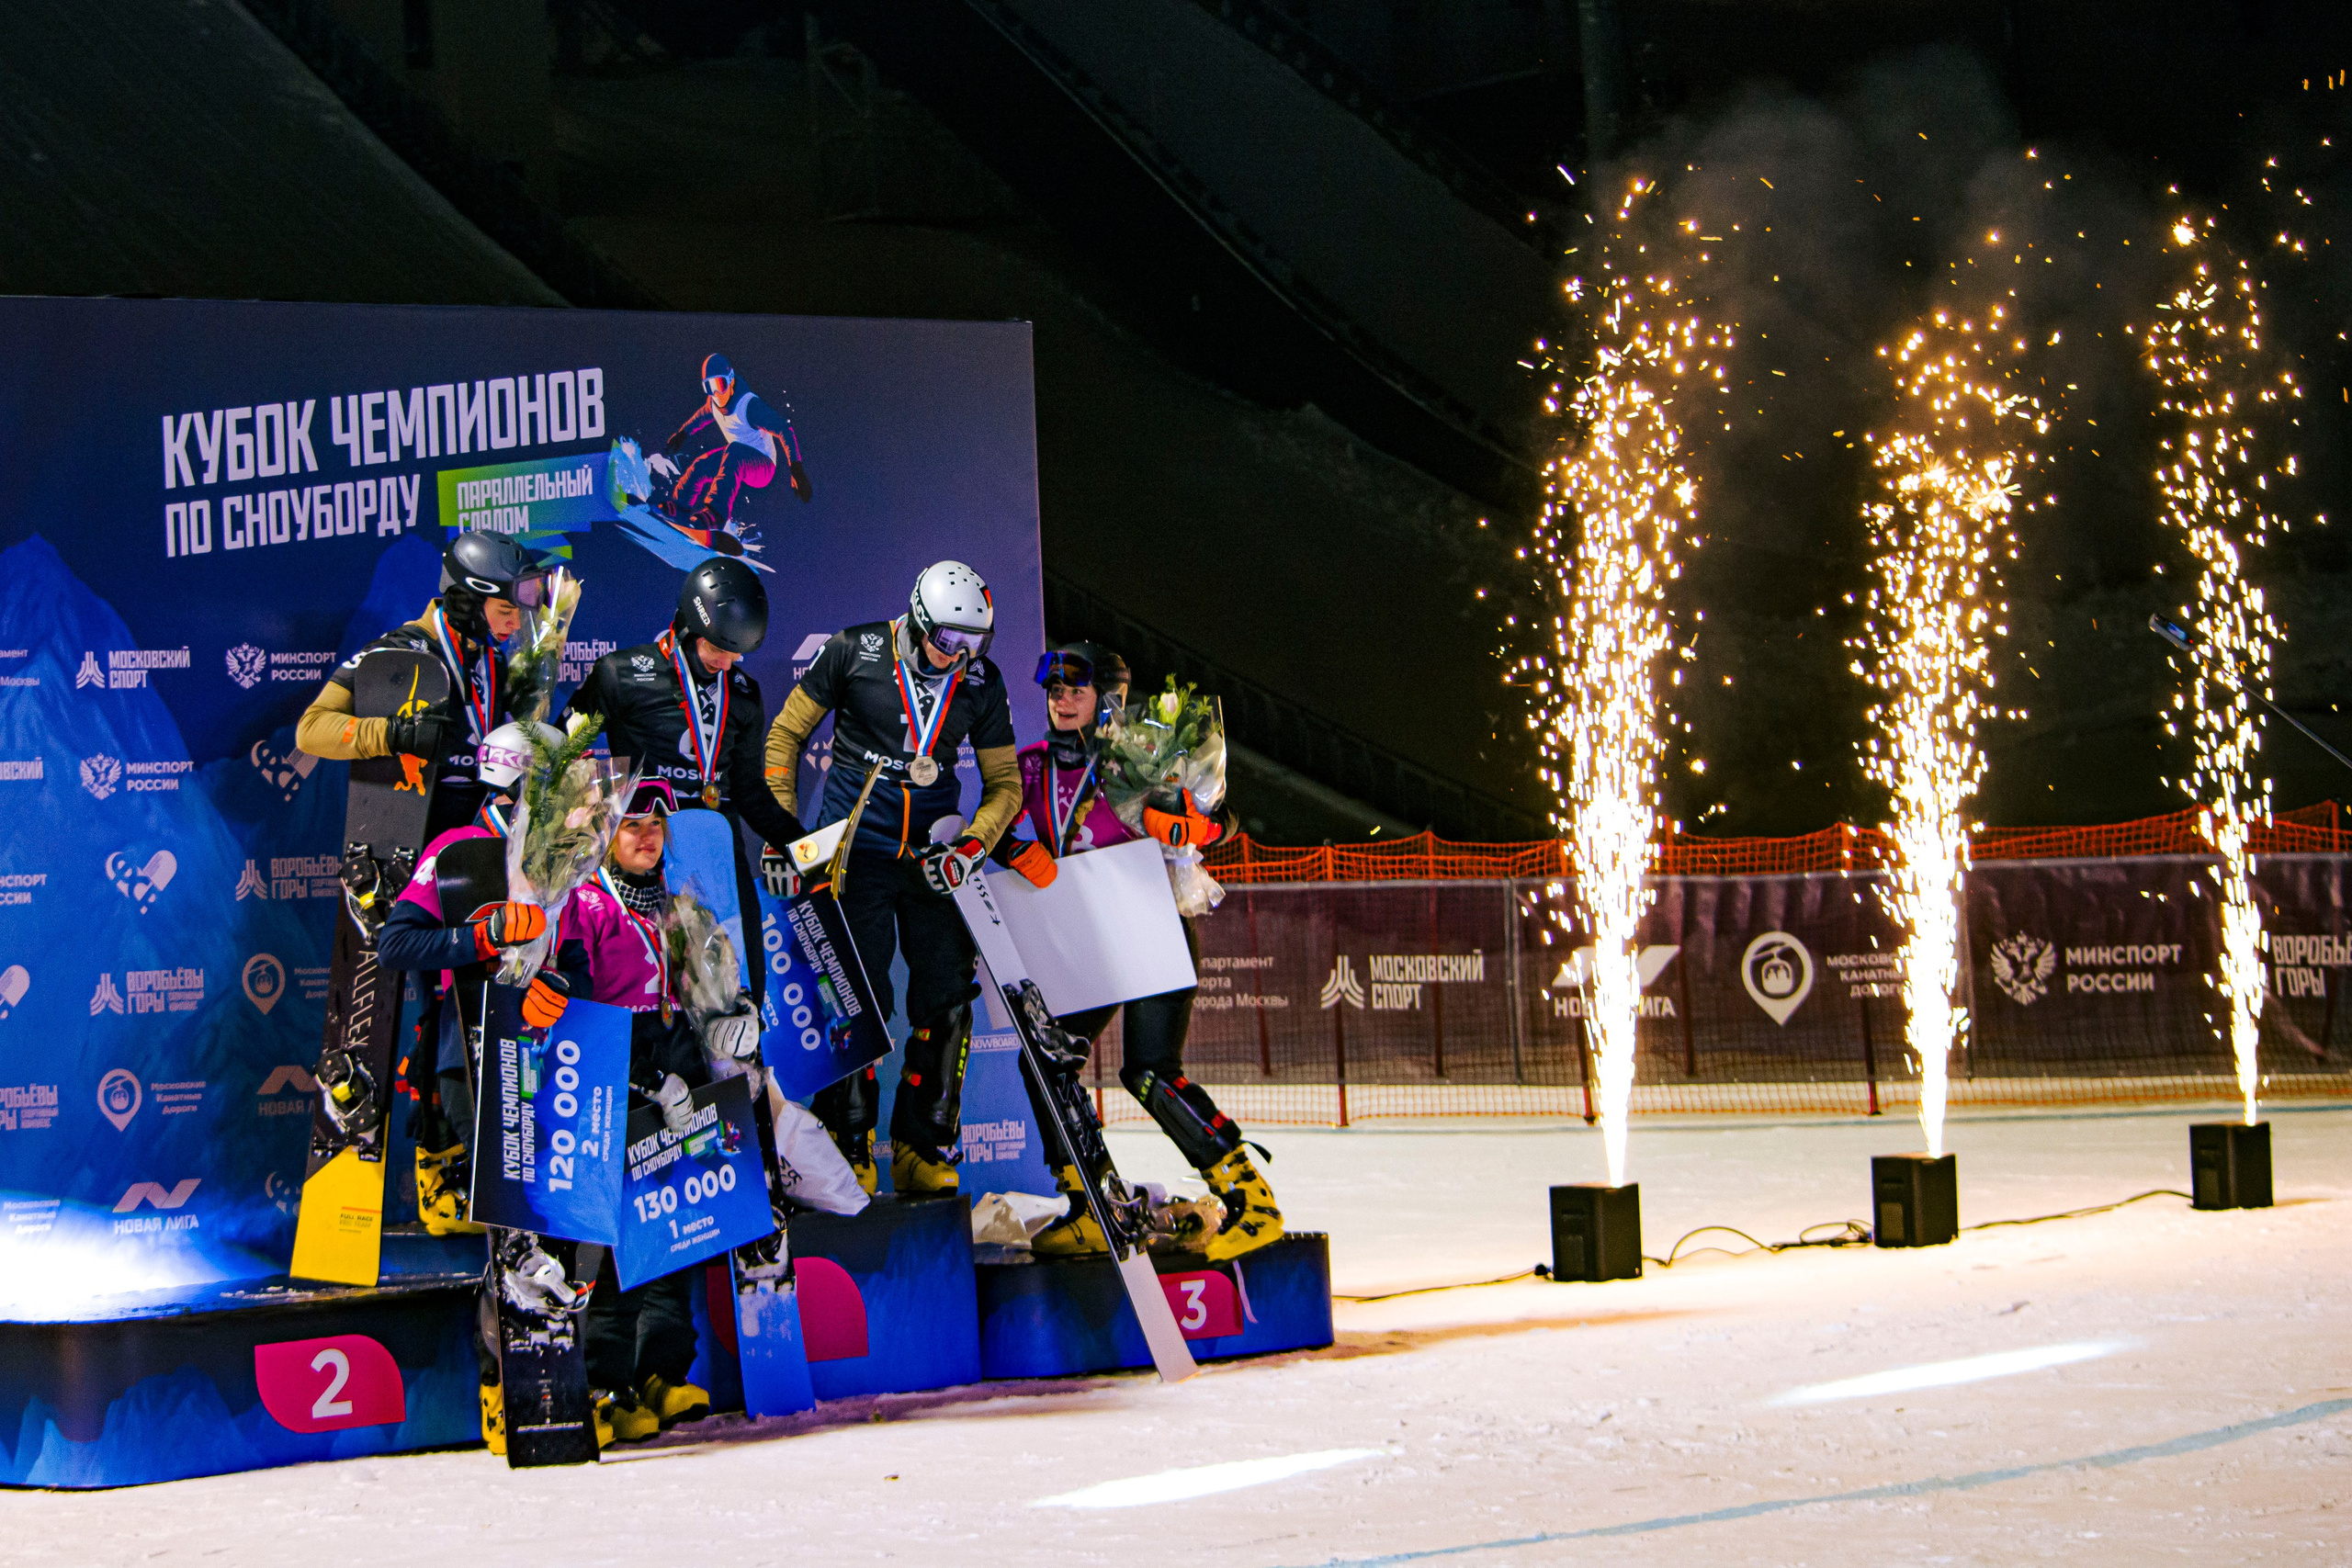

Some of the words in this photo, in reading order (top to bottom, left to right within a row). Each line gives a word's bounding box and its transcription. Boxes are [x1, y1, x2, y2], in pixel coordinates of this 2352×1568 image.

[163, 399, 319, 490] КУБОК
[331, 367, 605, 467] ЧЕМПИОНОВ
[458, 464, 594, 511] ПАРАЛЛЕЛЬНЫЙ
[165, 499, 212, 558] ПО
[222, 474, 421, 550] СНОУБОРДУ
[458, 505, 530, 536] СЛАЛОМ
[108, 645, 191, 670] МОСКОВСКИЙ
[270, 651, 336, 665] МИНСПОРТ
[109, 669, 149, 689] СПОРТ
[271, 669, 322, 682] РОССИИ
[126, 761, 194, 775] МИНСПОРТ
[127, 779, 179, 792] РОССИИ
[271, 877, 308, 899] ГОРЫ
[786, 908, 800, 923] ПО
[793, 921, 824, 974] СНОУБОРДУ
[2064, 942, 2185, 967] МИНСПОРТ
[797, 899, 827, 943] КУБОК
[819, 941, 863, 1017] ЧЕМПИОНОВ
[1200, 956, 1274, 972] партамент
[1369, 949, 1485, 982] МОСКОВСКИЙ
[127, 966, 204, 992] ВОРОБЬЁВЫ
[762, 912, 792, 975] 100
[783, 982, 821, 1051] 000
[2066, 971, 2156, 994] РОССИИ
[2275, 966, 2327, 998] ГОРЫ
[127, 991, 165, 1014] ГОРЫ
[1193, 995, 1234, 1010] орода
[1235, 992, 1290, 1008] Москвы
[1371, 983, 1422, 1010] СПОРТ
[500, 1038, 520, 1127] ЧЕМПИОНОВ
[553, 1040, 581, 1118] 000
[521, 1101, 536, 1166] СНОУБОРДУ
[582, 1139, 599, 1157] 2
[592, 1086, 603, 1135] место
[961, 1119, 1026, 1144] ВОРОБЬЁВЫ
[503, 1130, 521, 1180] КУБОК
[548, 1129, 576, 1192] 120
[628, 1132, 661, 1167] КУБОК
[631, 1164, 642, 1182] ПО
[642, 1143, 683, 1177] СНОУБОРДУ
[962, 1143, 993, 1164] ГОРЫ
[522, 1168, 536, 1183] ПО
[634, 1185, 678, 1224] 130
[684, 1164, 736, 1204] 000
[114, 1216, 163, 1235] НОВАЯ
[165, 1213, 199, 1231] ЛИГА
[669, 1219, 679, 1239] 1
[683, 1215, 715, 1235] место
[1180, 1279, 1207, 1330] 3
[311, 1348, 353, 1419] 2
